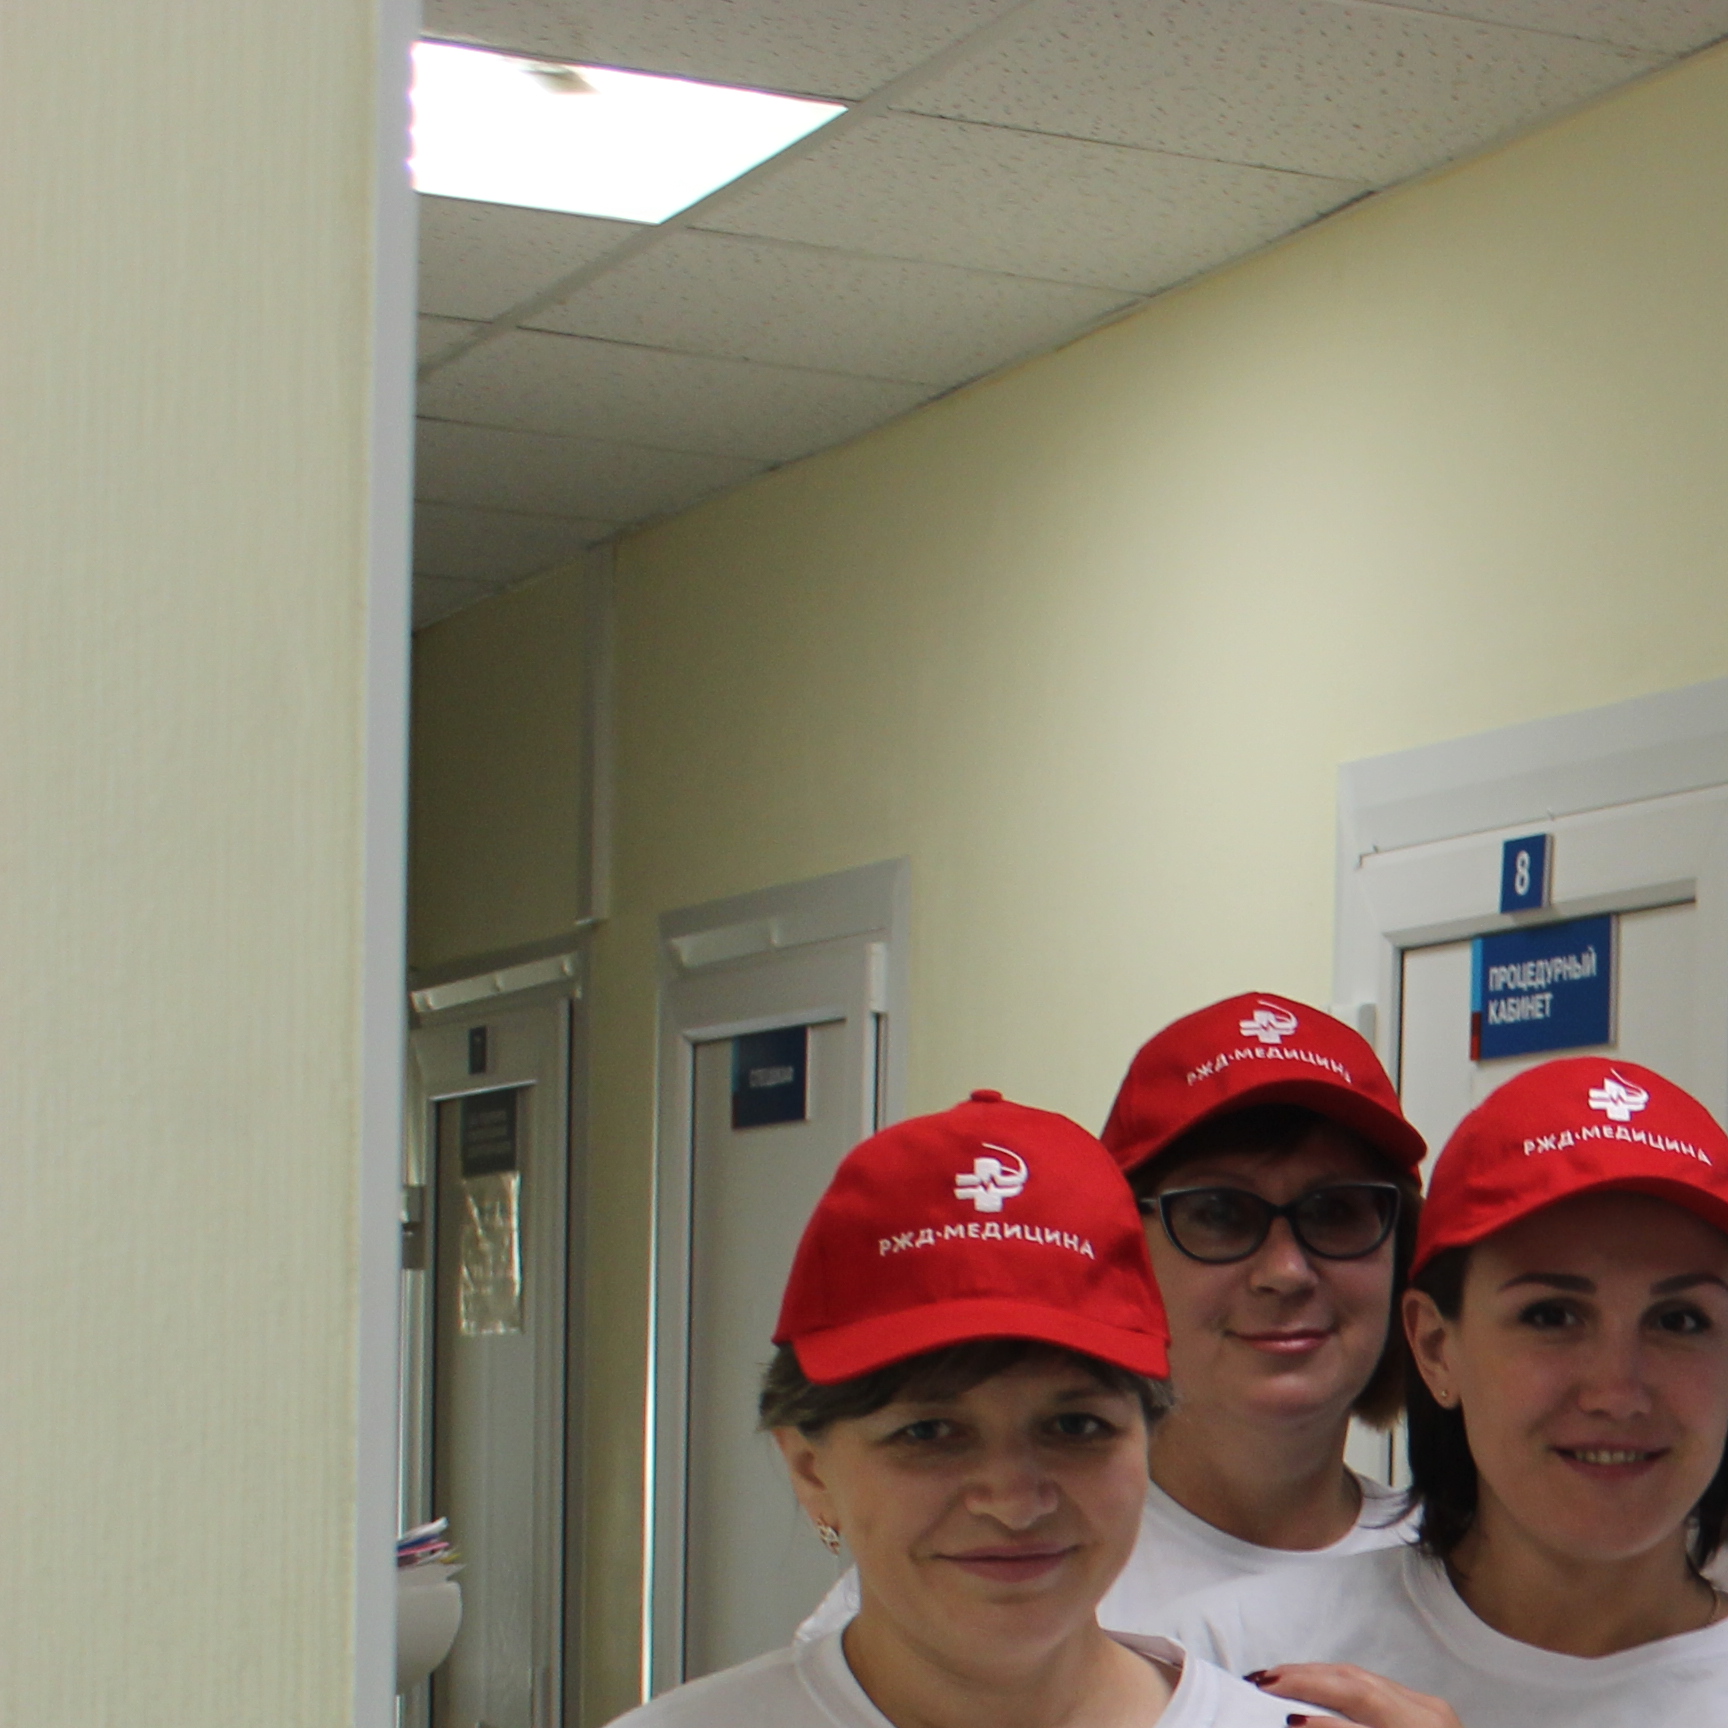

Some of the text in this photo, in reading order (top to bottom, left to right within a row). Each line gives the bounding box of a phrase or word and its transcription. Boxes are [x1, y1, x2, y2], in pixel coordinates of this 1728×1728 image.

[1513, 850, 1532, 896] 8
[1488, 945, 1598, 992] ПРОЦЕДУРНЫЙ
[1488, 992, 1554, 1025] КАБИНЕТ
